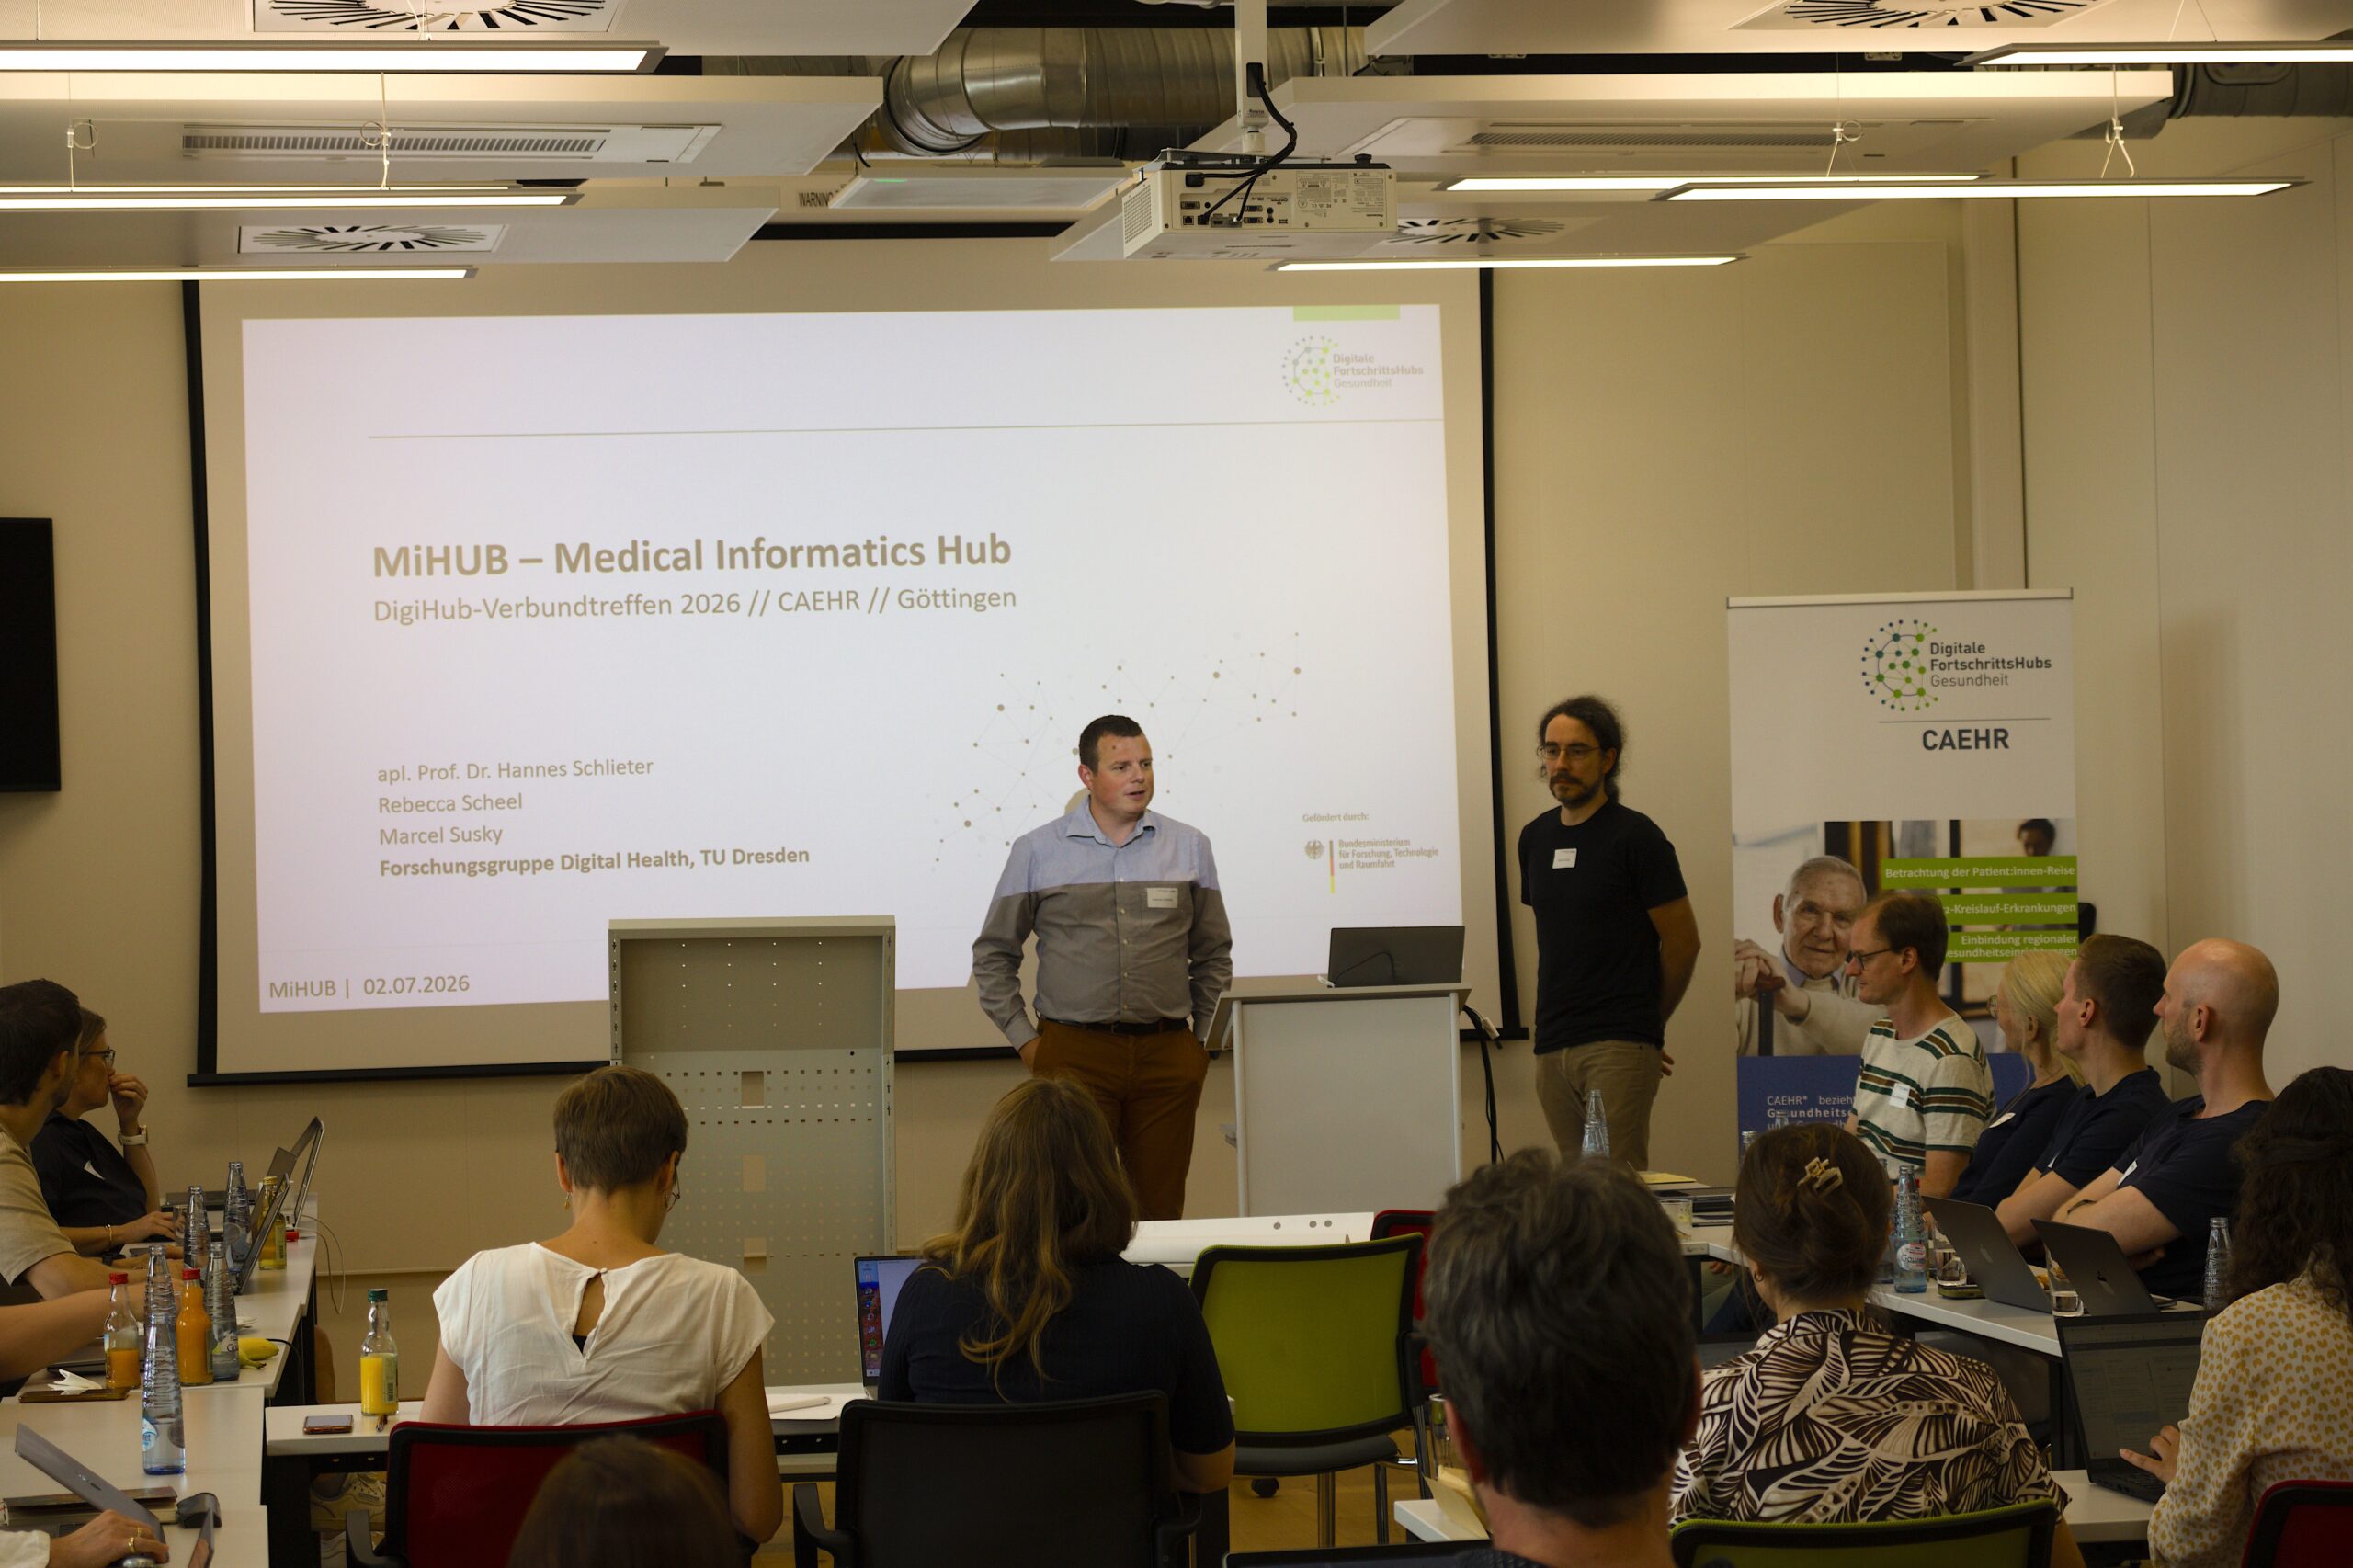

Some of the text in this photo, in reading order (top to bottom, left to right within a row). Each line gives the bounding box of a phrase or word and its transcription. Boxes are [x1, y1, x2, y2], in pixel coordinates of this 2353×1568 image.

[1334, 354, 1375, 366] Digitale
[1334, 365, 1425, 376] FortschrittsHubs
[1334, 378, 1392, 388] Gesundheit
[374, 545, 508, 577] MiHUB
[556, 539, 702, 573] Medical
[717, 536, 925, 570] Informatics
[938, 533, 1011, 564] Hub
[375, 587, 1016, 625] DigiHub-Verbundtreffen 2026 // CAEHR // Göttingen
[1931, 642, 1986, 657] Digitale
[1931, 657, 2052, 671] FortschrittsHubs
[1931, 674, 2008, 687] Gesundheit
[1923, 729, 2009, 750] CAEHR
[378, 759, 654, 785] apl. Prof. Dr. Hannes Schlieter
[380, 793, 522, 813] Rebecca Scheel
[1302, 812, 1369, 822] Gefördert durch:
[381, 825, 503, 845] Marcel Susky
[1338, 838, 1411, 848] Bundesministerium
[1338, 847, 1439, 859] für Forschung, Technologie
[381, 847, 809, 877] Forschungsgruppe Digital Health, TU Dresden
[1356, 859, 1395, 869] Raumfahrt
[1886, 866, 2075, 879] Betrachtung der Patient:innen-Reise
[1961, 935, 2076, 946] Einbindung regionaler
[270, 981, 335, 998] MiHUB
[364, 975, 469, 994] 02.07.2026
